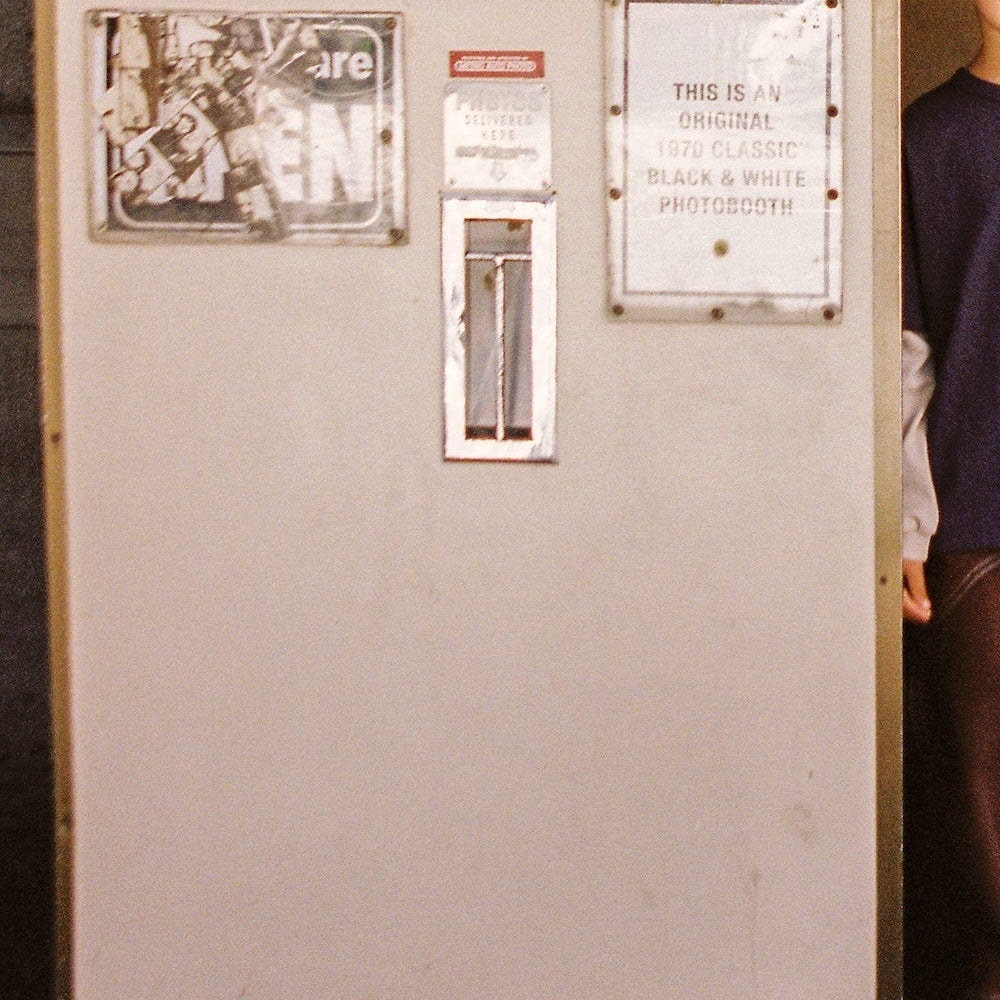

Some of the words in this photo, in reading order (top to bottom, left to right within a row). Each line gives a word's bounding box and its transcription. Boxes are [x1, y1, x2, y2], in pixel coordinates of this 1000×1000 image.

[673, 82, 719, 102] THIS
[726, 83, 746, 102] IS
[753, 84, 781, 103] AN
[678, 111, 776, 131] ORIGINAL
[656, 139, 704, 159] 1970
[711, 140, 799, 160] CLASSIC
[646, 167, 713, 187] BLACK
[720, 170, 736, 187] &
[742, 168, 807, 189] WHITE
[659, 196, 794, 216] PHOTOBOOTH
